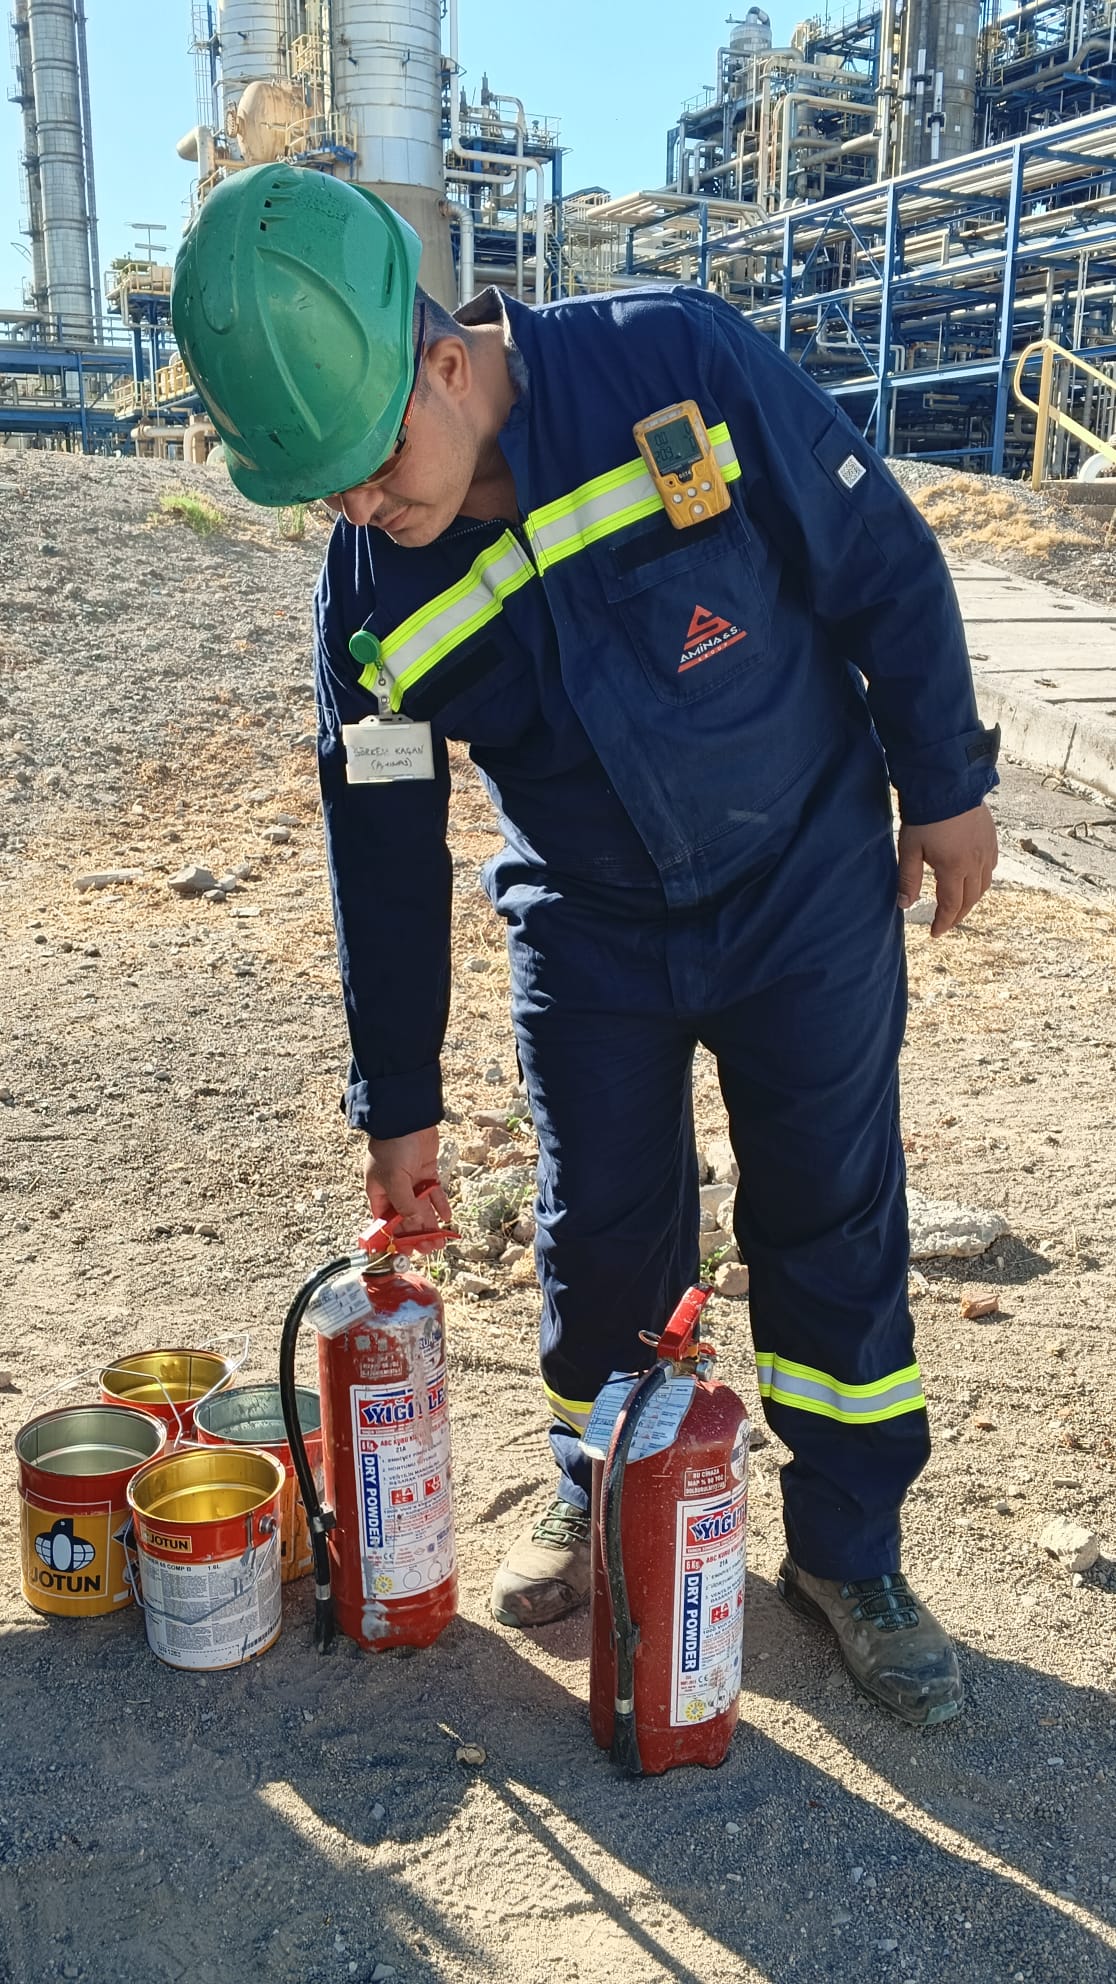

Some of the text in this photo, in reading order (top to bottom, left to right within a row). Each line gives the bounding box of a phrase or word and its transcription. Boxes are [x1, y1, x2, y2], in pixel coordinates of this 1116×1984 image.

[364, 1457, 376, 1484] DRY
[150, 1533, 189, 1550] JOTUN
[32, 1567, 101, 1592] JOTUN
[687, 1576, 699, 1605] DRY
[685, 1609, 698, 1670] POWDER
